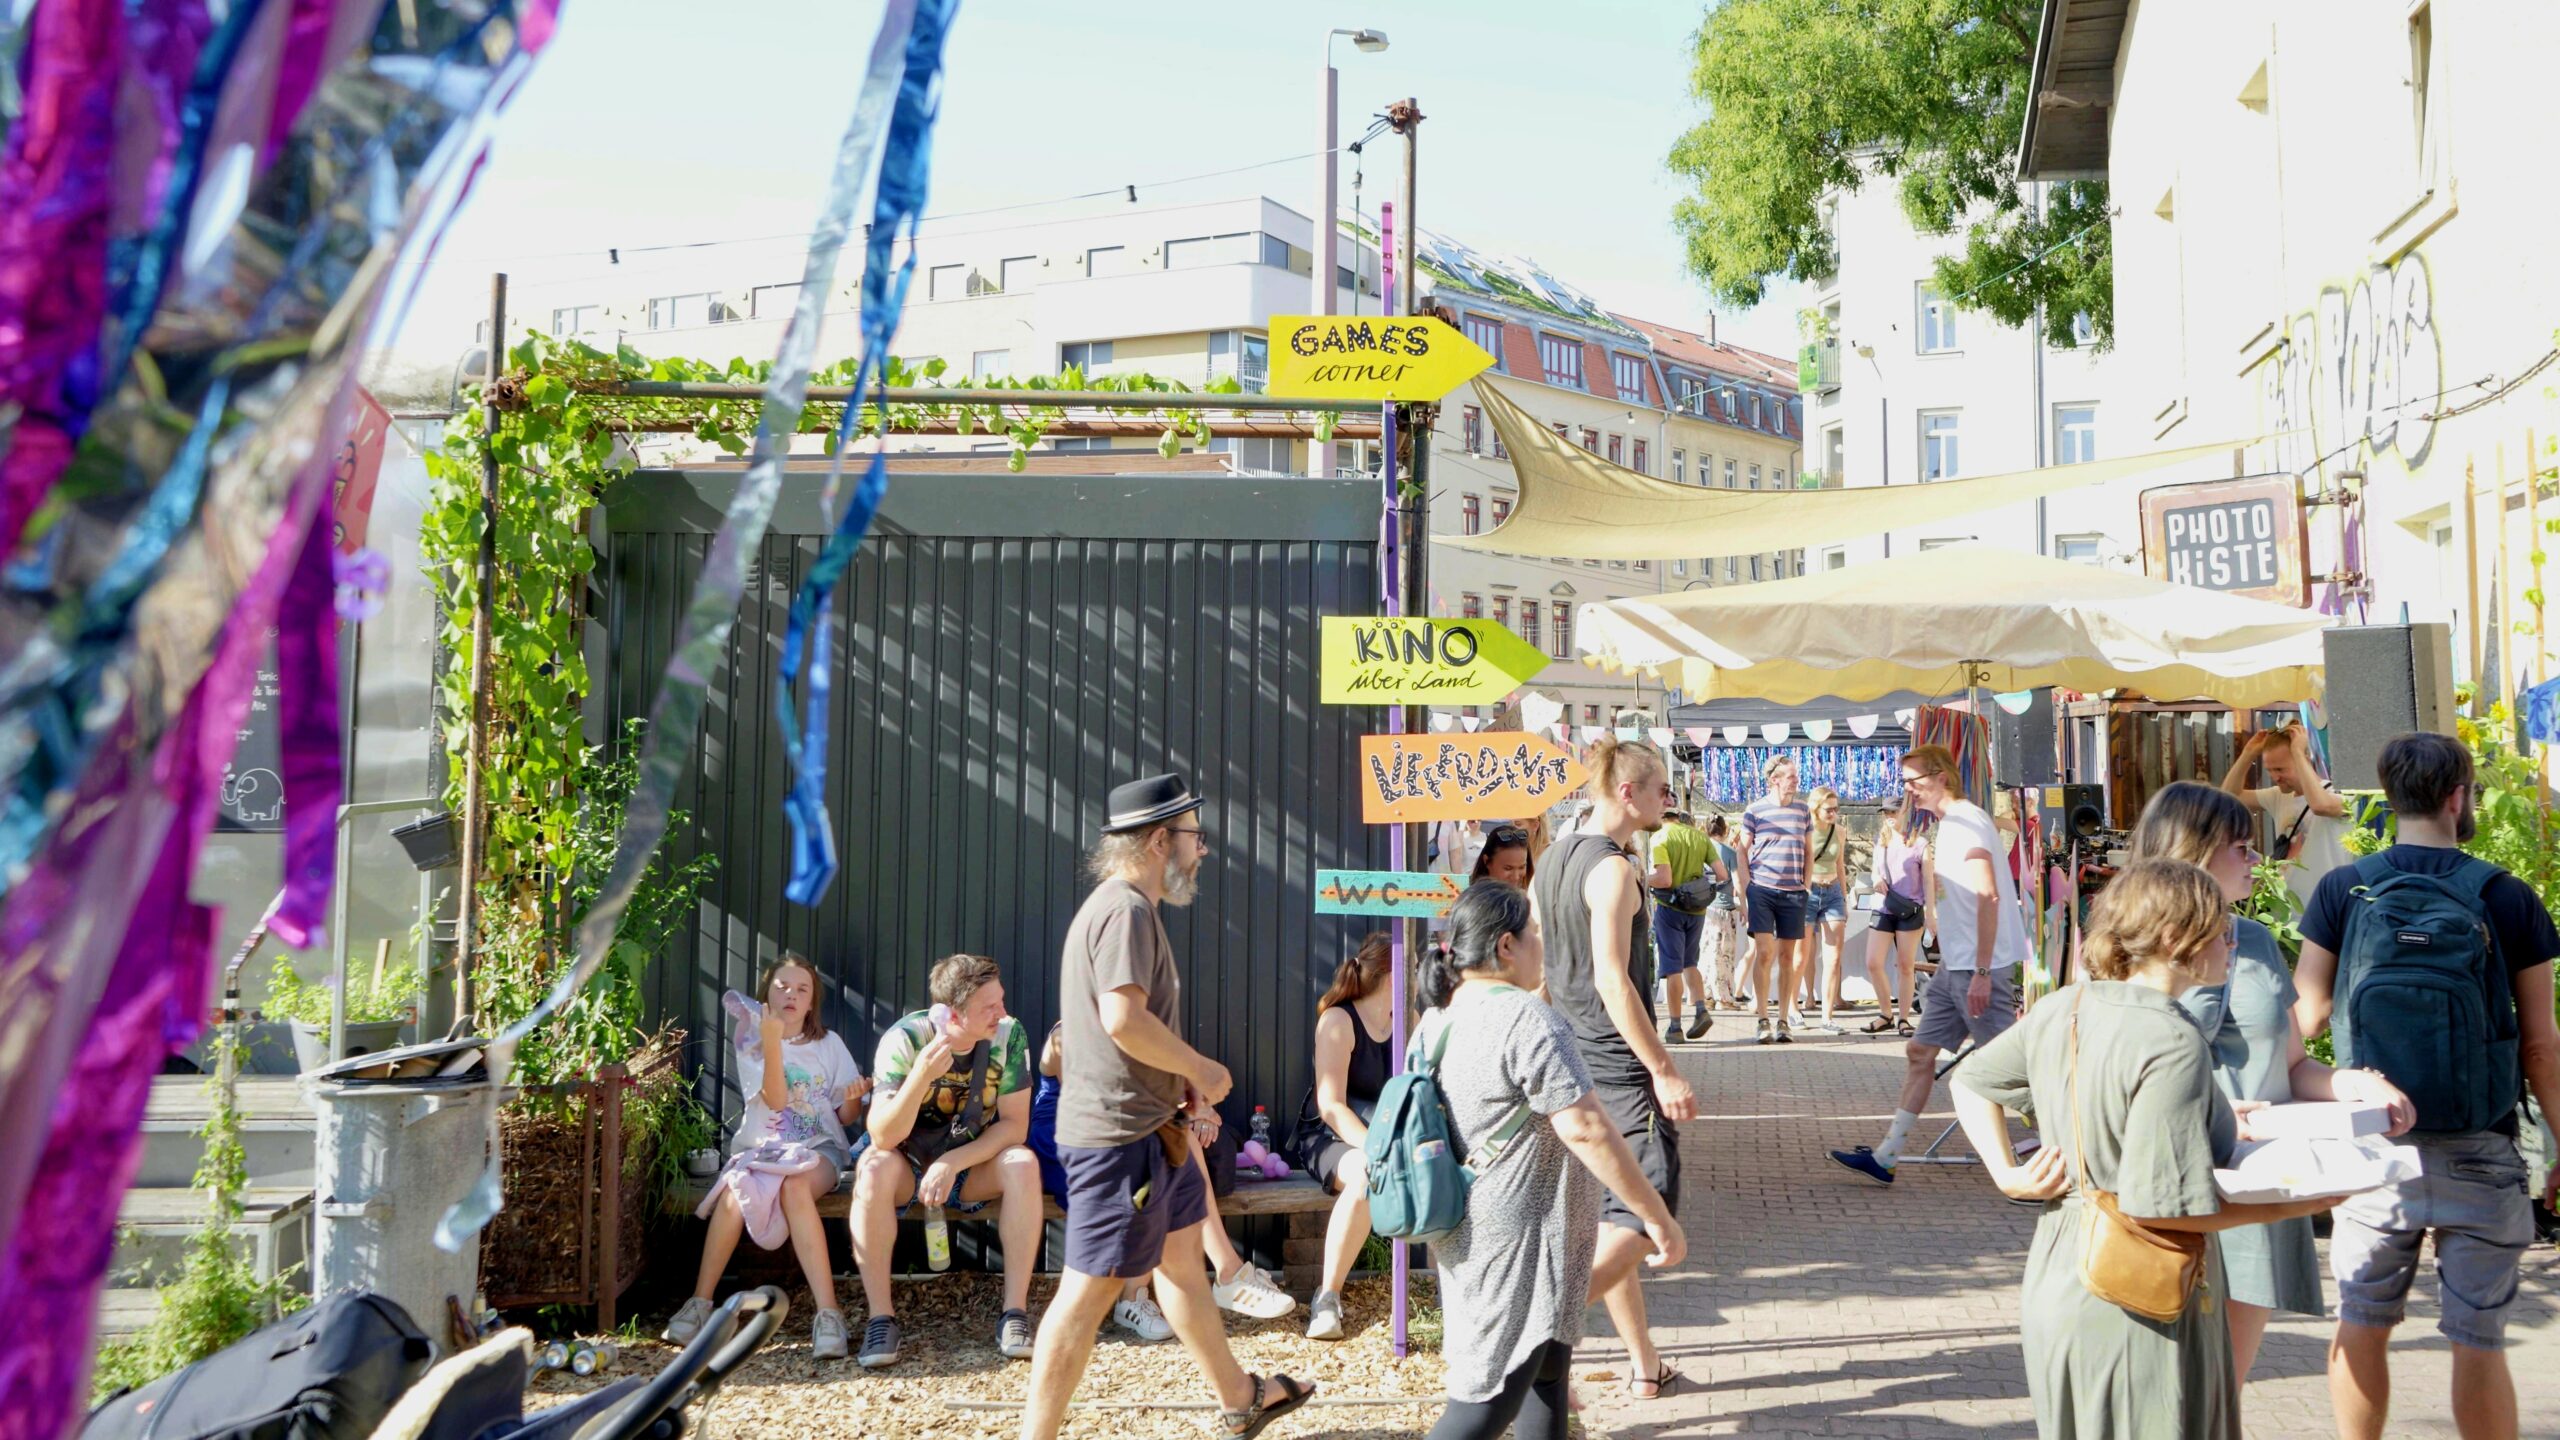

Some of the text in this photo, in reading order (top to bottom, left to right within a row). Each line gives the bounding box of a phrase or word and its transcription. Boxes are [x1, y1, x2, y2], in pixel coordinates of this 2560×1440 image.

[1291, 321, 1429, 357] GAMES
[1304, 364, 1414, 384] corner
[2167, 504, 2271, 547] PHOTO
[1347, 668, 1483, 693] über Land
